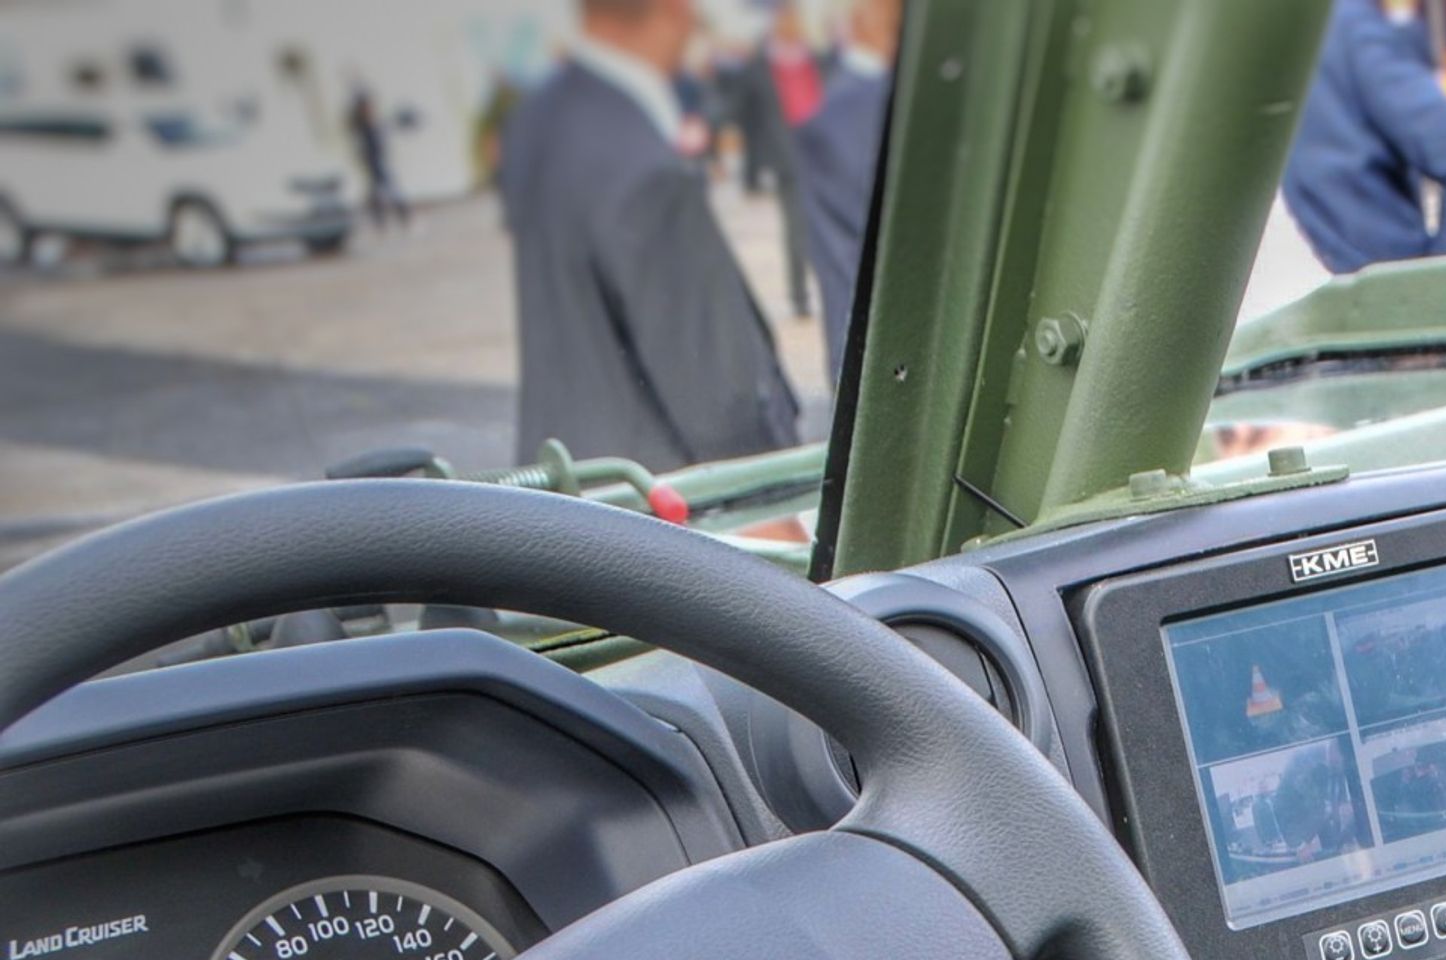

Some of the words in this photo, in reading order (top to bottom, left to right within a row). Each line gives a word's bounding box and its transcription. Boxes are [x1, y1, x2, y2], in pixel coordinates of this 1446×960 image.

[1301, 546, 1369, 575] KME
[9, 933, 63, 960] LAND
[65, 914, 149, 948] CRUISER
[308, 916, 350, 942] 100
[355, 915, 394, 940] 120
[275, 936, 308, 959] 80
[393, 929, 432, 953] 140
